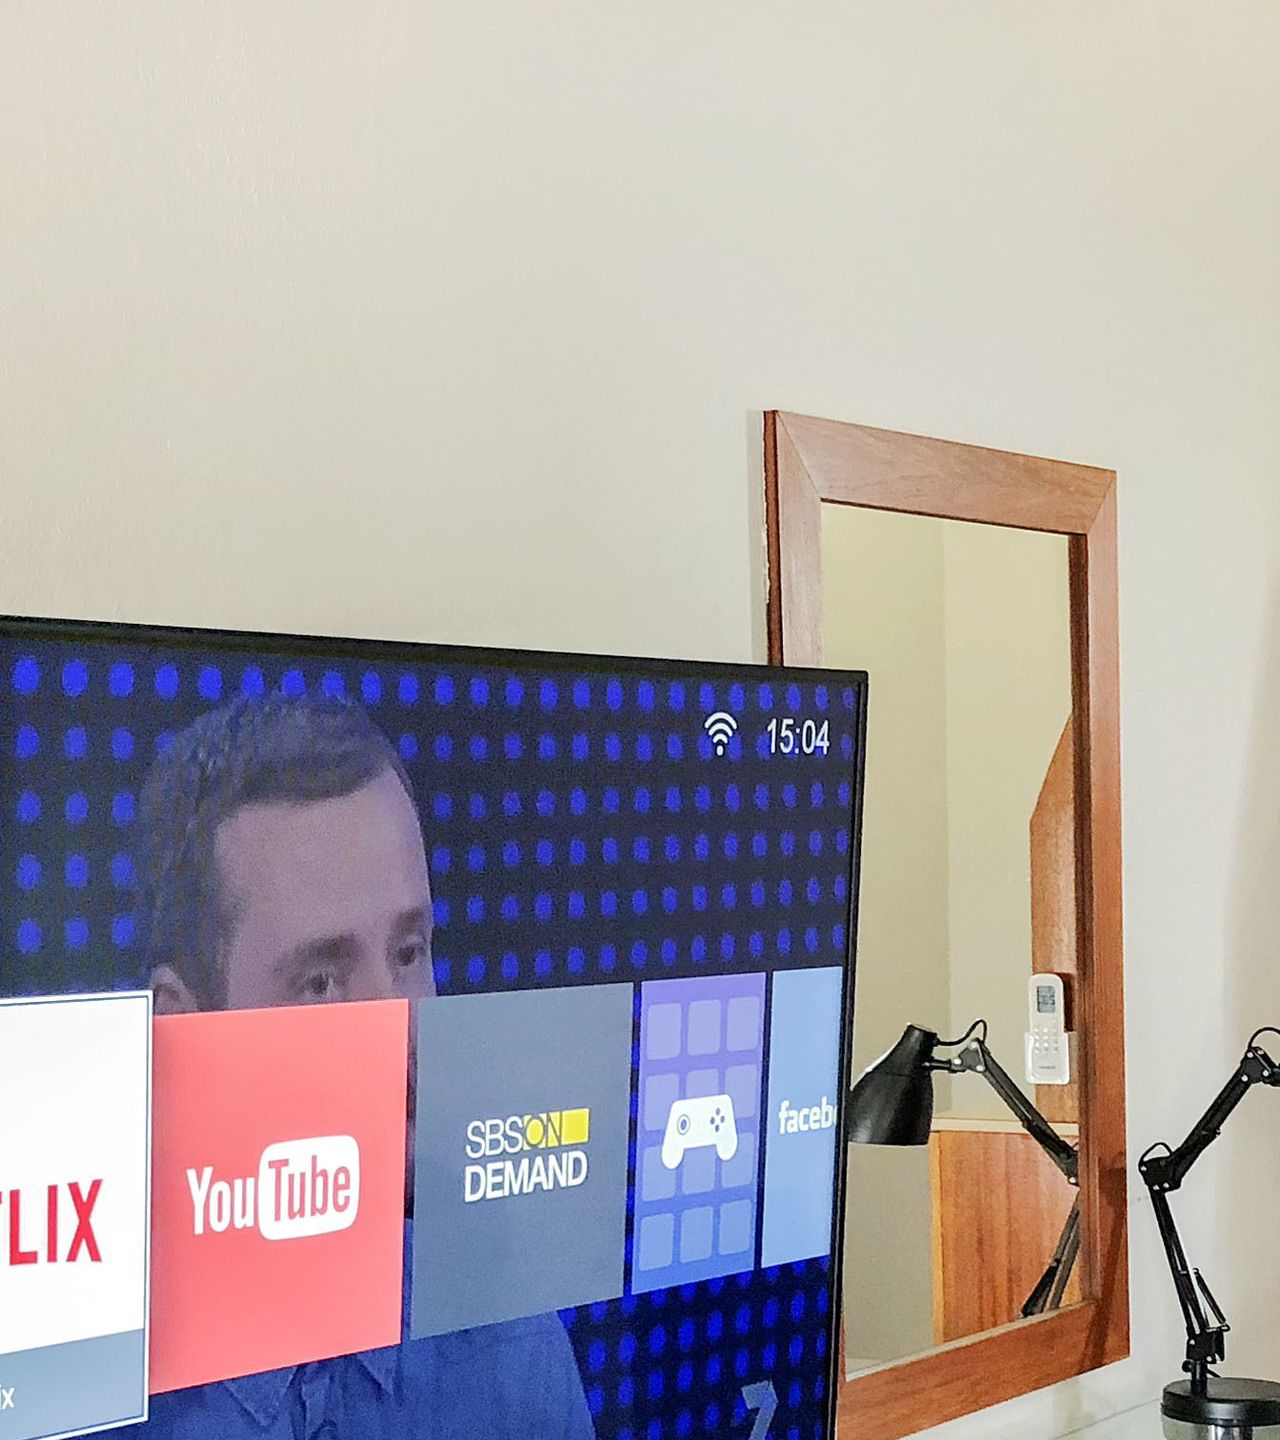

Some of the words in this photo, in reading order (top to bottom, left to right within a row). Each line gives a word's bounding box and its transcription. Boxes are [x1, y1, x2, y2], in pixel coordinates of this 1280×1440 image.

[767, 717, 829, 755] 15:04
[778, 1095, 837, 1135] faceb
[186, 1152, 353, 1236] YouTube
[464, 1150, 588, 1202] DEMAND
